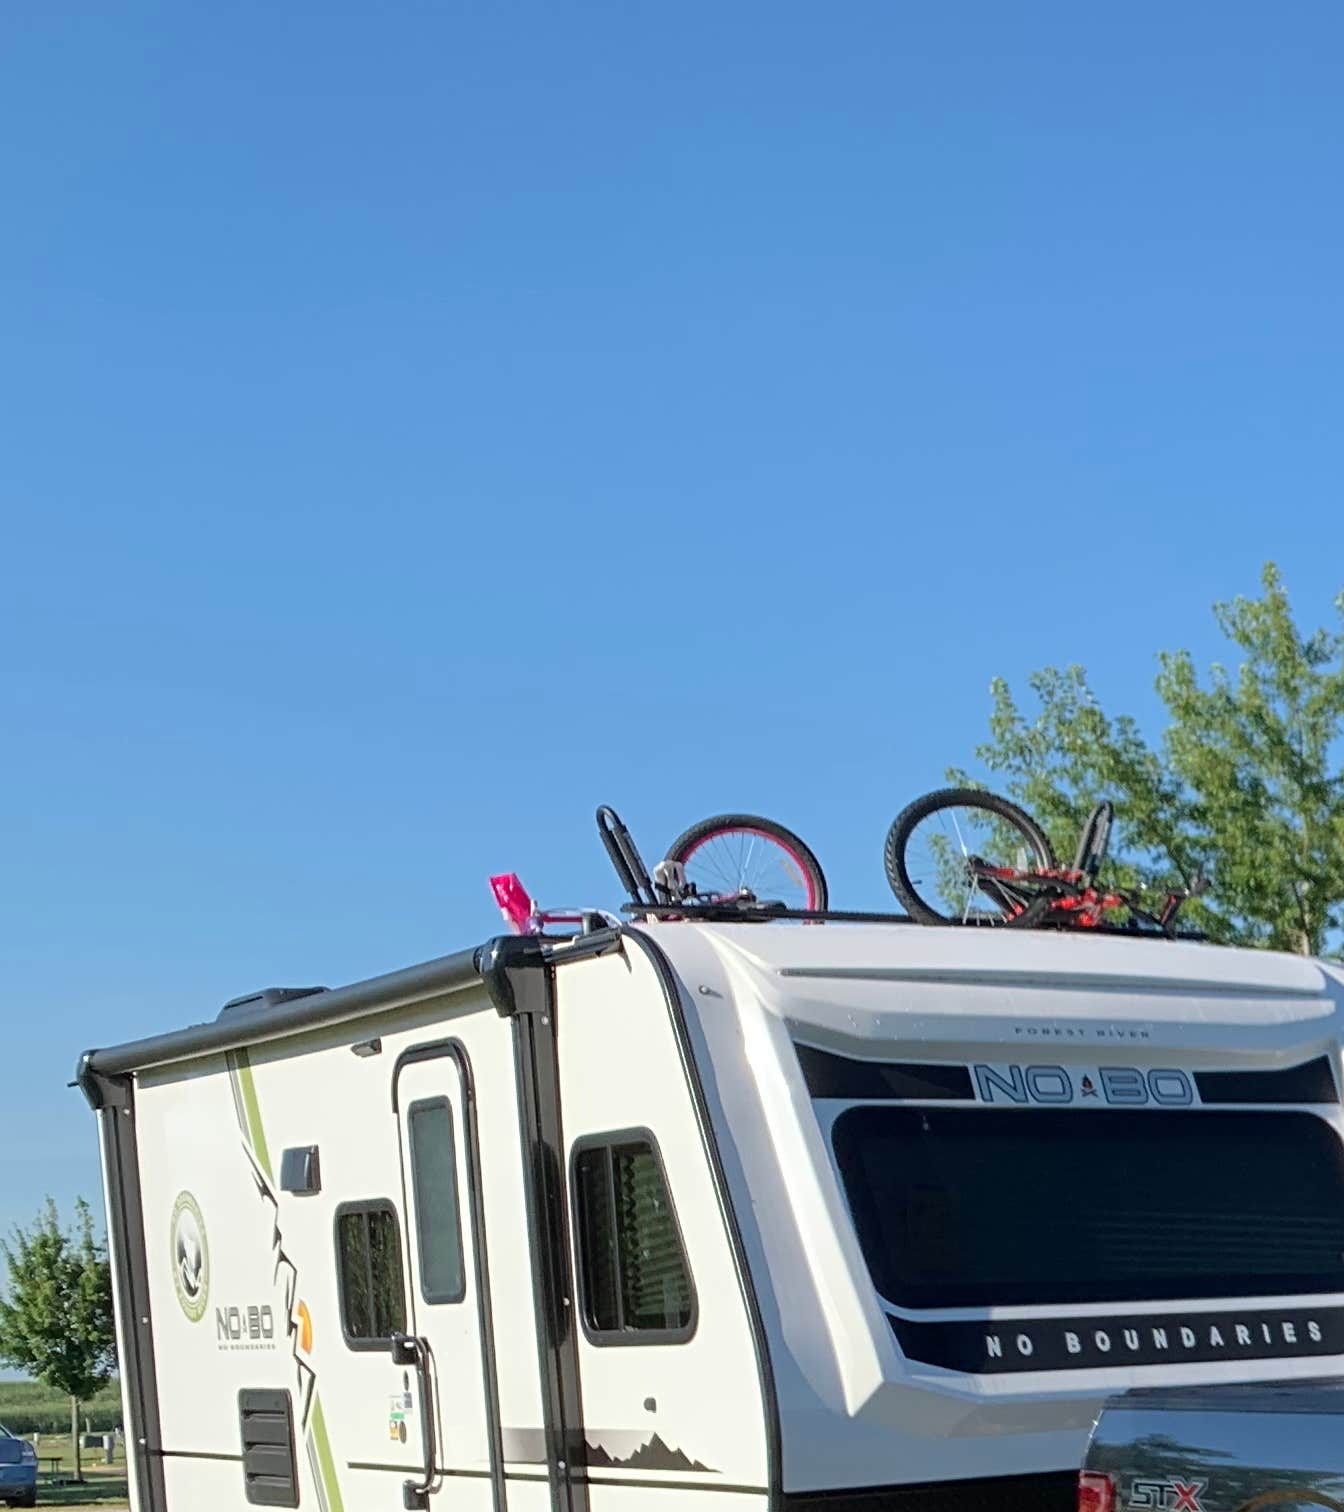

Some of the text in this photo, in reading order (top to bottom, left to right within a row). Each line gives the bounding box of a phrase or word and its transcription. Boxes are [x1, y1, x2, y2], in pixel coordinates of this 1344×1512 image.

[1015, 1026, 1149, 1039] FOREST RIVER
[974, 1064, 1194, 1106] NO BO
[986, 1320, 1323, 1358] NO BOUNDARIES
